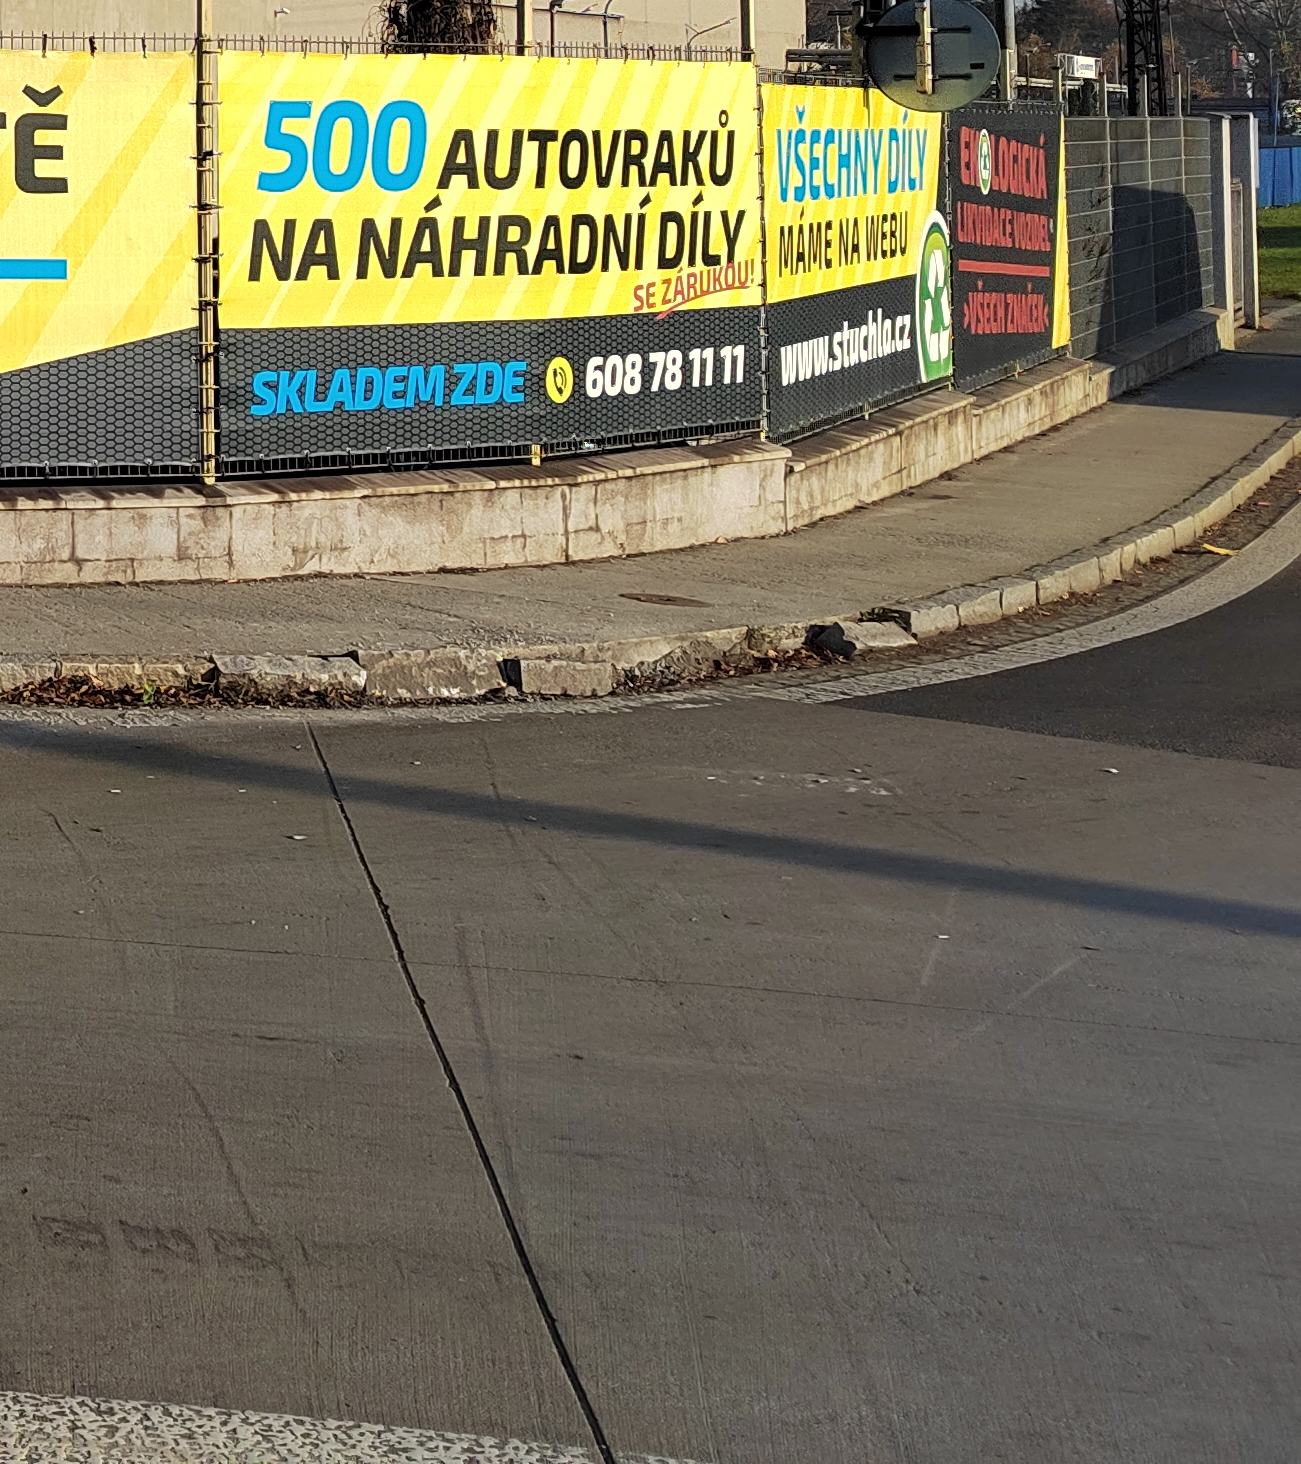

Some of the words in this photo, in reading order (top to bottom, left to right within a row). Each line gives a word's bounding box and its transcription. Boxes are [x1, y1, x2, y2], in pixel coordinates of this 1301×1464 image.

[256, 100, 427, 193] 500
[436, 109, 736, 190] AUTOVRAKŮ
[775, 104, 884, 203] VŠECHNY
[887, 109, 928, 194] DÍLY
[248, 218, 341, 282] NA
[356, 193, 652, 279] NÁHRADNÍ
[657, 192, 746, 270] DÍLY
[778, 205, 833, 278] MÁME
[838, 216, 860, 267] NA
[865, 210, 908, 261] WEBU
[957, 200, 1013, 248] LIKVIDACE
[1013, 209, 1051, 252] VOZIDEL
[633, 282, 656, 312] SE
[661, 258, 755, 306] ZÁRUKOU!
[250, 365, 445, 416] SKLADEM
[450, 360, 527, 406] ZDE
[585, 352, 643, 399] 608
[649, 349, 684, 392] 78
[690, 346, 715, 388] 11
[719, 344, 746, 385] 11
[780, 307, 911, 387] www.stuchla.cz
